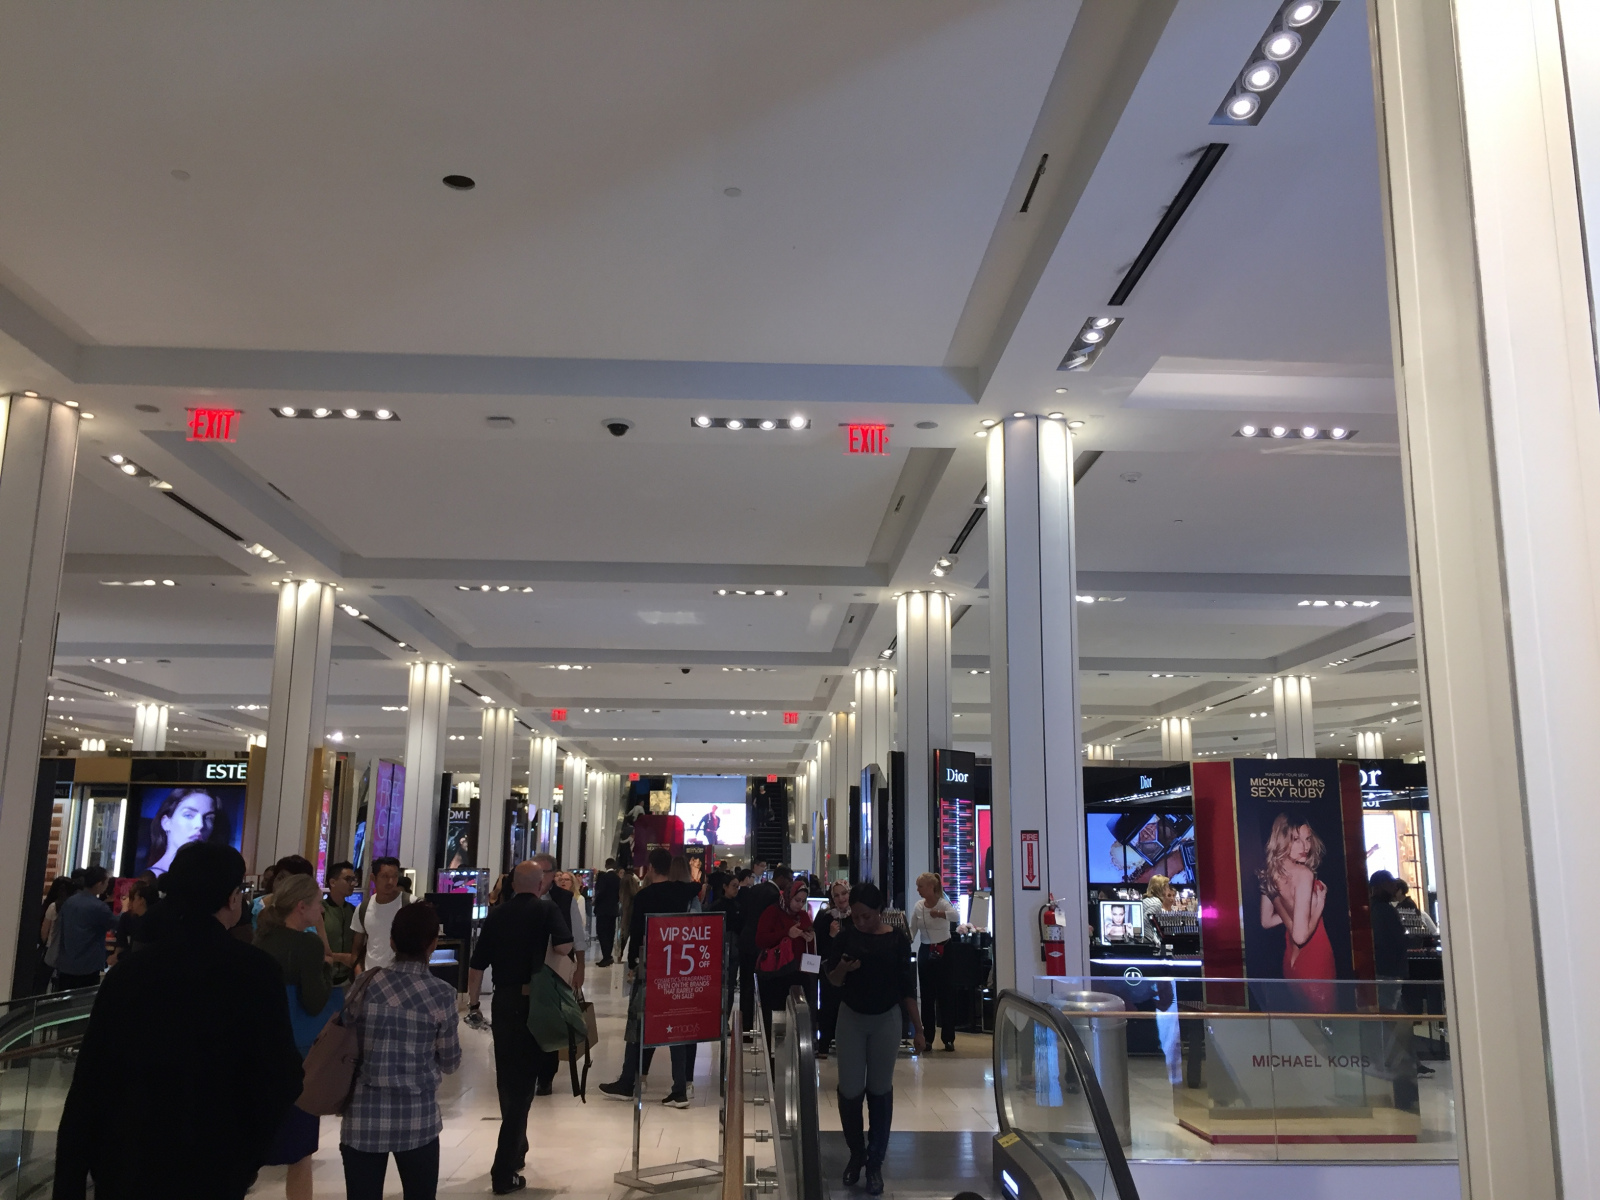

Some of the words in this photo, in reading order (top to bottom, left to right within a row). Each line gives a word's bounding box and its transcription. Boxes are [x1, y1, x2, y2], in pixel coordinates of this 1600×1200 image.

[193, 409, 235, 439] EXIT
[849, 425, 886, 453] EXIT
[946, 768, 969, 783] Dior
[1140, 775, 1152, 789] Dior
[1250, 778, 1294, 787] MICHAEL
[1298, 778, 1325, 788] KORS
[1250, 787, 1285, 797] SEXY
[1290, 787, 1325, 798] RUBY
[1022, 833, 1038, 841] FIRE
[660, 927, 680, 941] VIP
[682, 926, 711, 941] SALE
[657, 982, 670, 990] EVEN
[1252, 1055, 1322, 1068] MICHAEL
[1328, 1055, 1371, 1068] KORS
